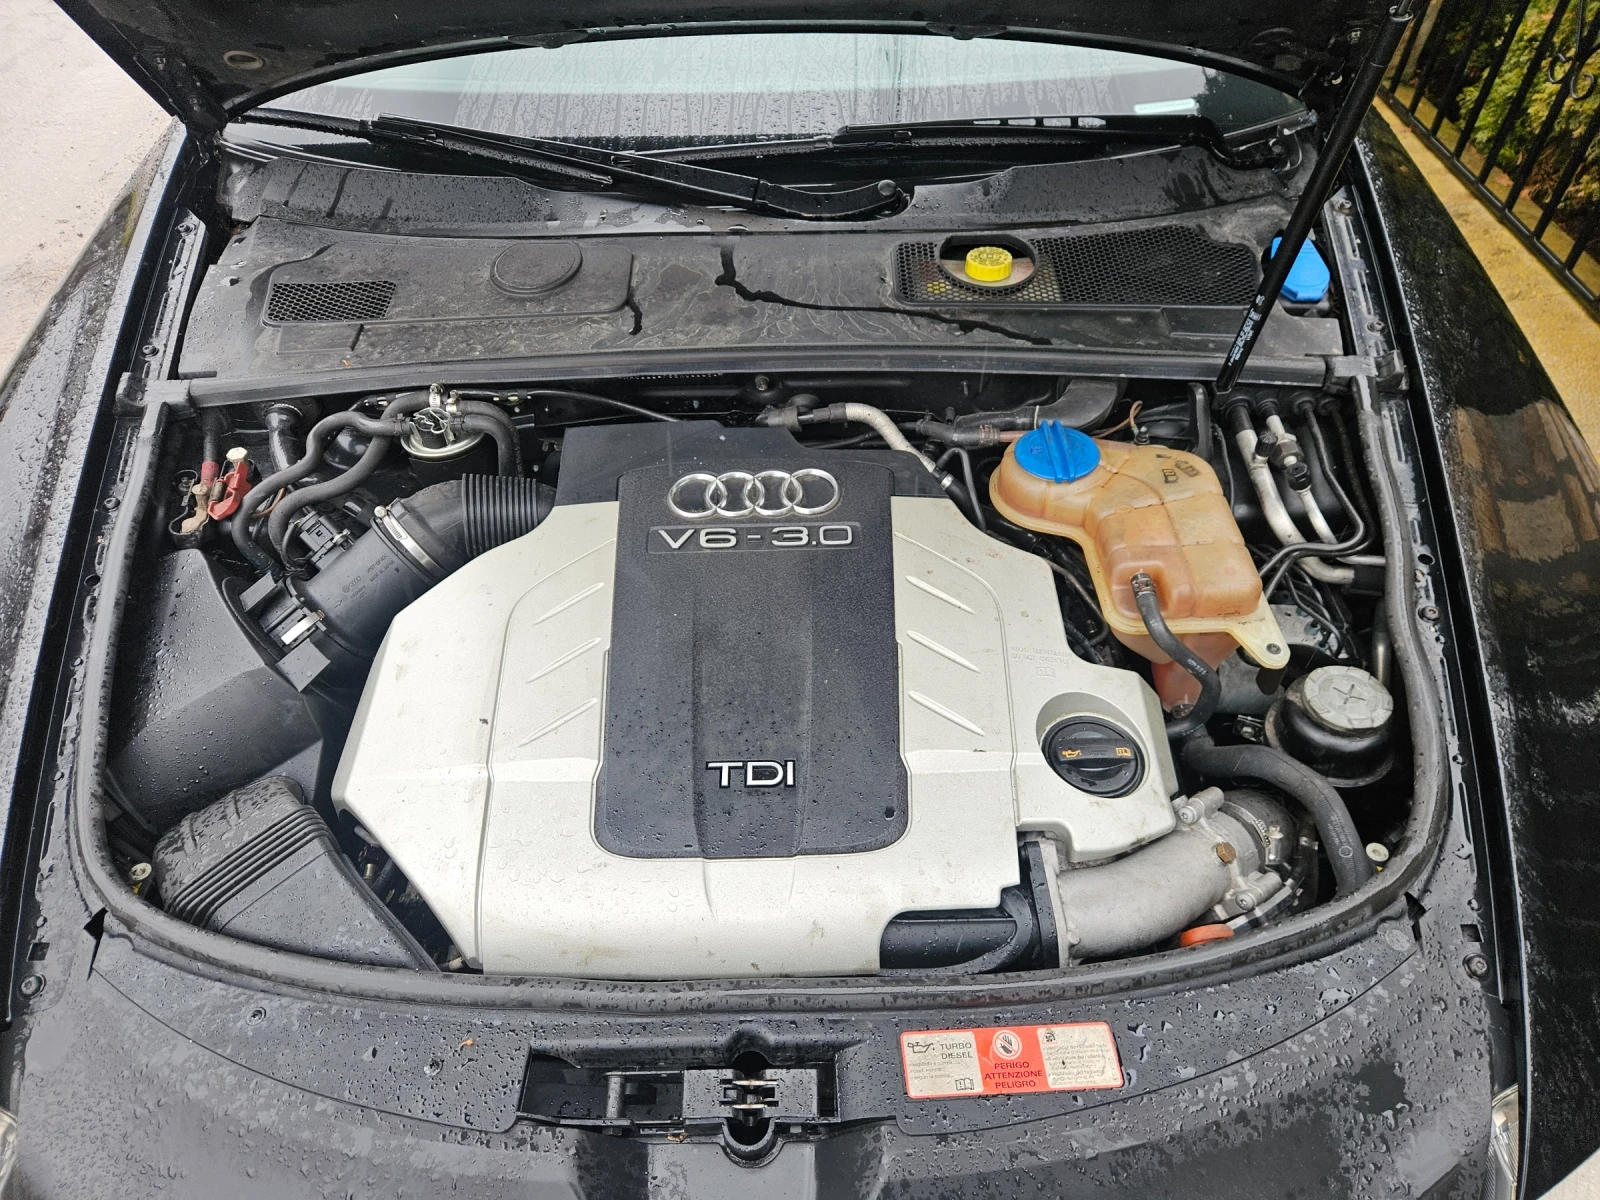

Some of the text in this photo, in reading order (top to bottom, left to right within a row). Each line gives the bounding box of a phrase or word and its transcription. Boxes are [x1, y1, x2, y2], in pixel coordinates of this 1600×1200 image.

[706, 761, 795, 787] TDI
[939, 1042, 972, 1051] TURBO
[941, 1051, 973, 1060] DIESEL
[994, 1061, 1030, 1070] PERIGO
[984, 1069, 1044, 1081] ATTENZIONE
[994, 1079, 1036, 1090] PELIGRO
